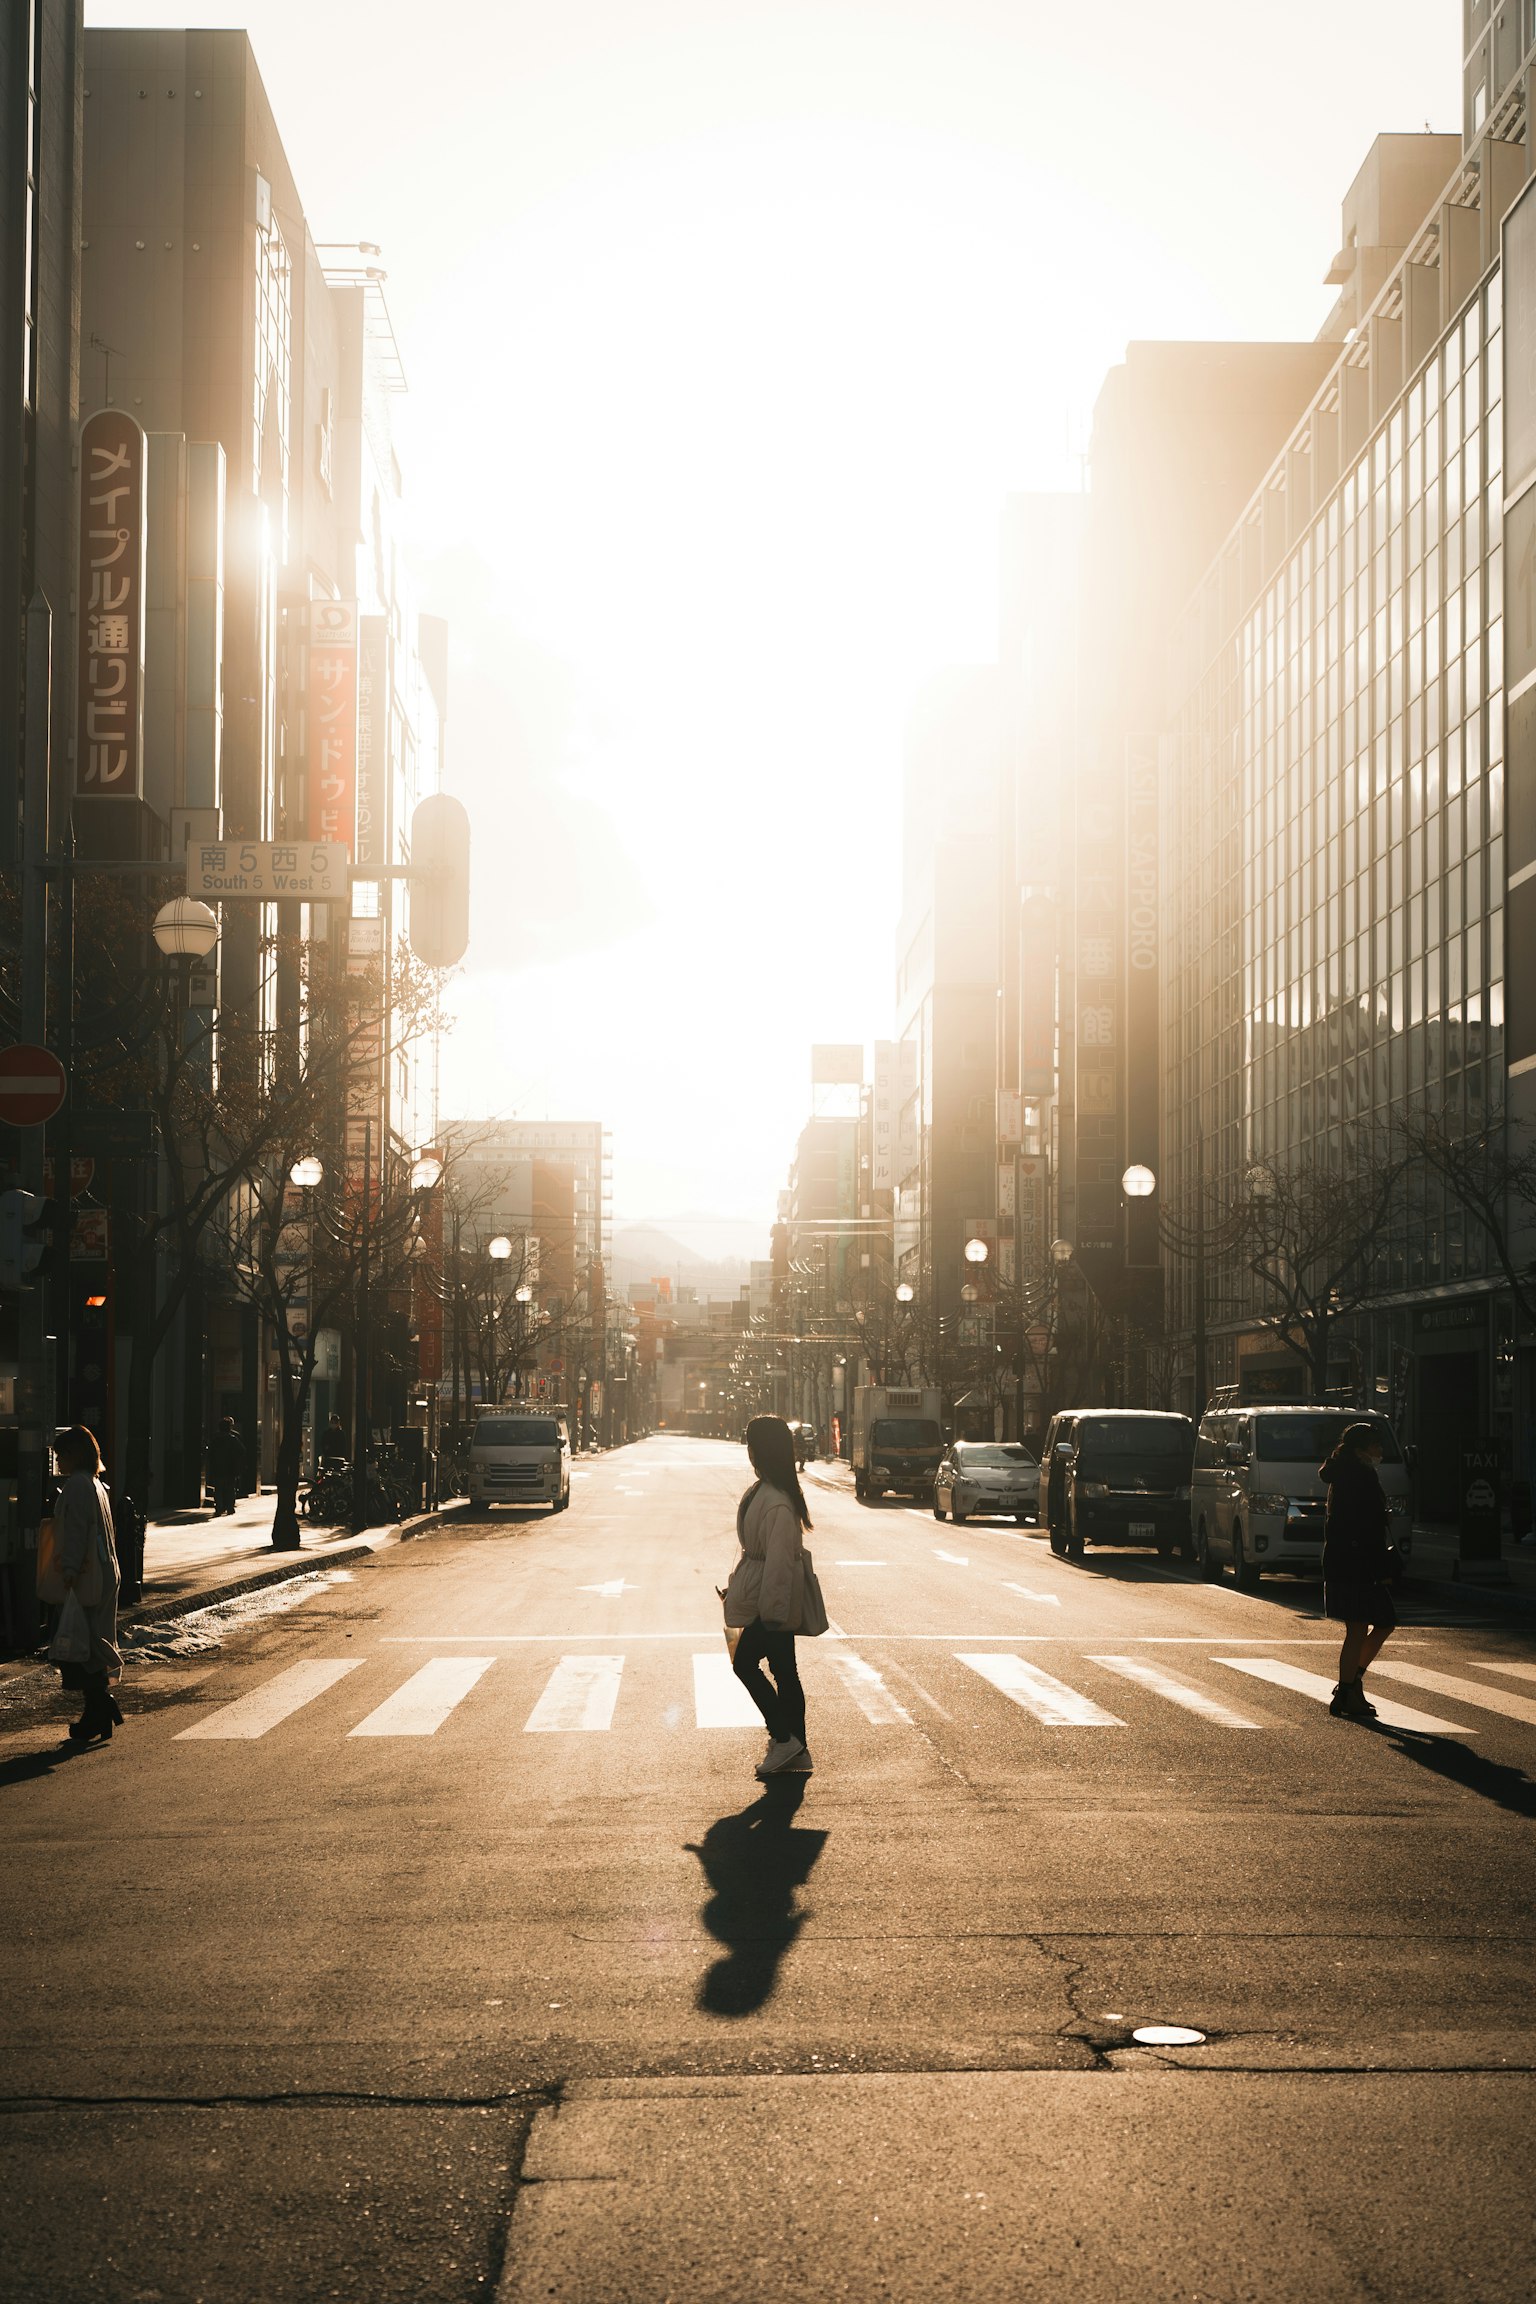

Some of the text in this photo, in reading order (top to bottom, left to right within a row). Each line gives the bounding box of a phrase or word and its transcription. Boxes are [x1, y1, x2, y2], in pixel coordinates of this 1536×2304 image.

[84, 442, 132, 783] メイプル通りビル
[316, 658, 351, 845] サン・ドウビ
[200, 844, 329, 873] 南 5 西 5
[202, 874, 332, 890] South 5 West 5
[1131, 832, 1157, 970] SAPPORO
[1463, 1452, 1499, 1468] TAXI
